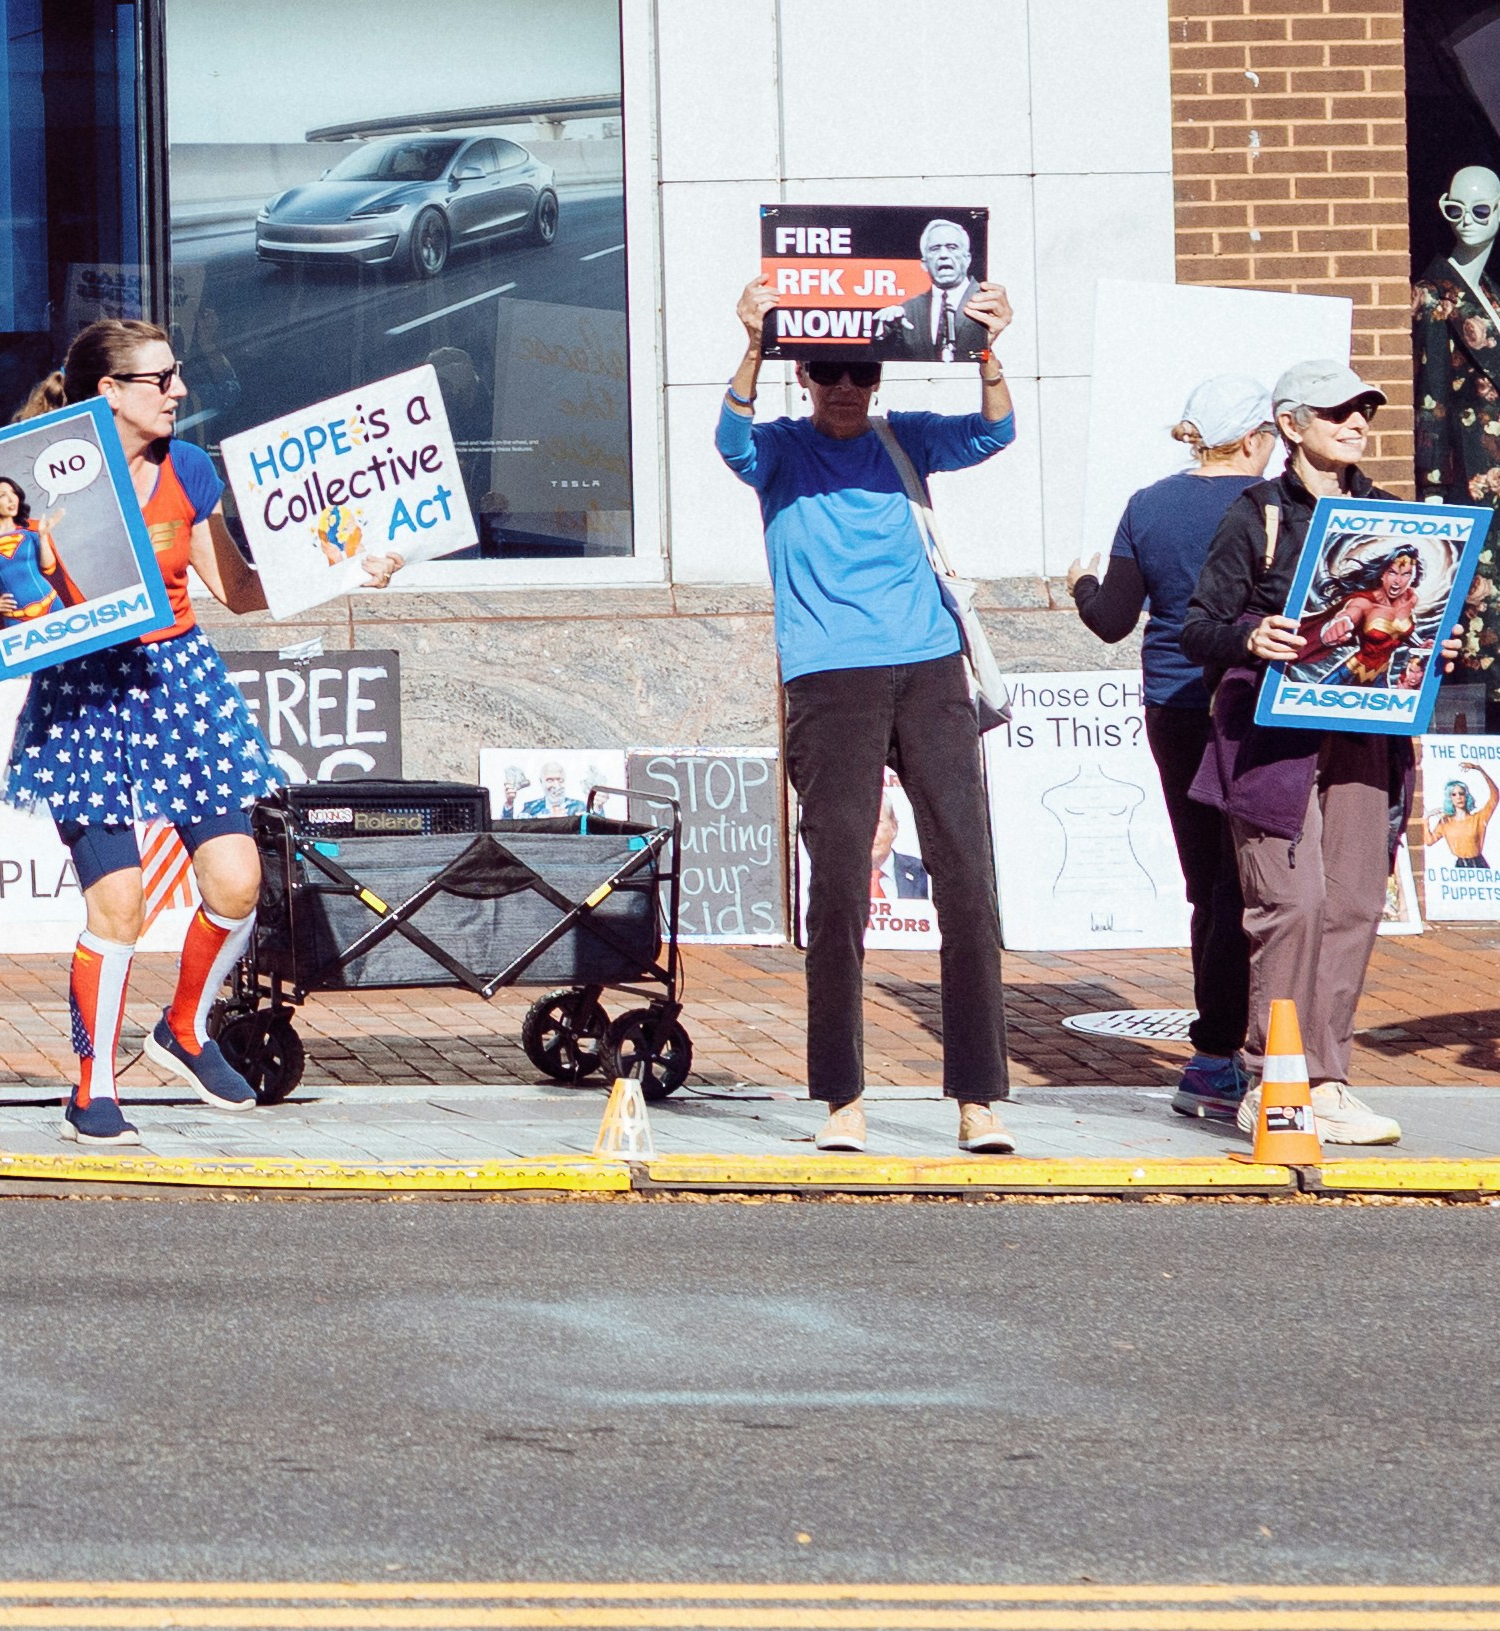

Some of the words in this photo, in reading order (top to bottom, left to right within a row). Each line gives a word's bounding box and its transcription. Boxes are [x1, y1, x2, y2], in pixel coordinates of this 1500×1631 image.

[775, 226, 852, 255] FIRE
[776, 268, 845, 296] RFK
[853, 268, 906, 297] JR.
[776, 309, 873, 338] NOW!
[249, 418, 352, 486] HOPE
[355, 404, 390, 444] is
[406, 395, 432, 425] a
[48, 454, 87, 480] NO
[263, 444, 443, 532] Collective
[550, 479, 601, 488] TESLA
[387, 484, 452, 541] Act
[1328, 515, 1384, 532] NOT
[1388, 518, 1472, 537] TODAY
[1, 592, 150, 657] FASCISM
[1098, 682, 1143, 708] CH
[1278, 686, 1417, 713] FASCISM
[1046, 716, 1143, 748] This?
[1430, 744, 1457, 759] THE
[645, 756, 769, 814] STOP
[354, 812, 423, 831] Roland
[680, 864, 749, 898] our
[1440, 867, 1500, 883] CORPORA
[869, 903, 892, 916] OR
[866, 918, 930, 932] ATORS
